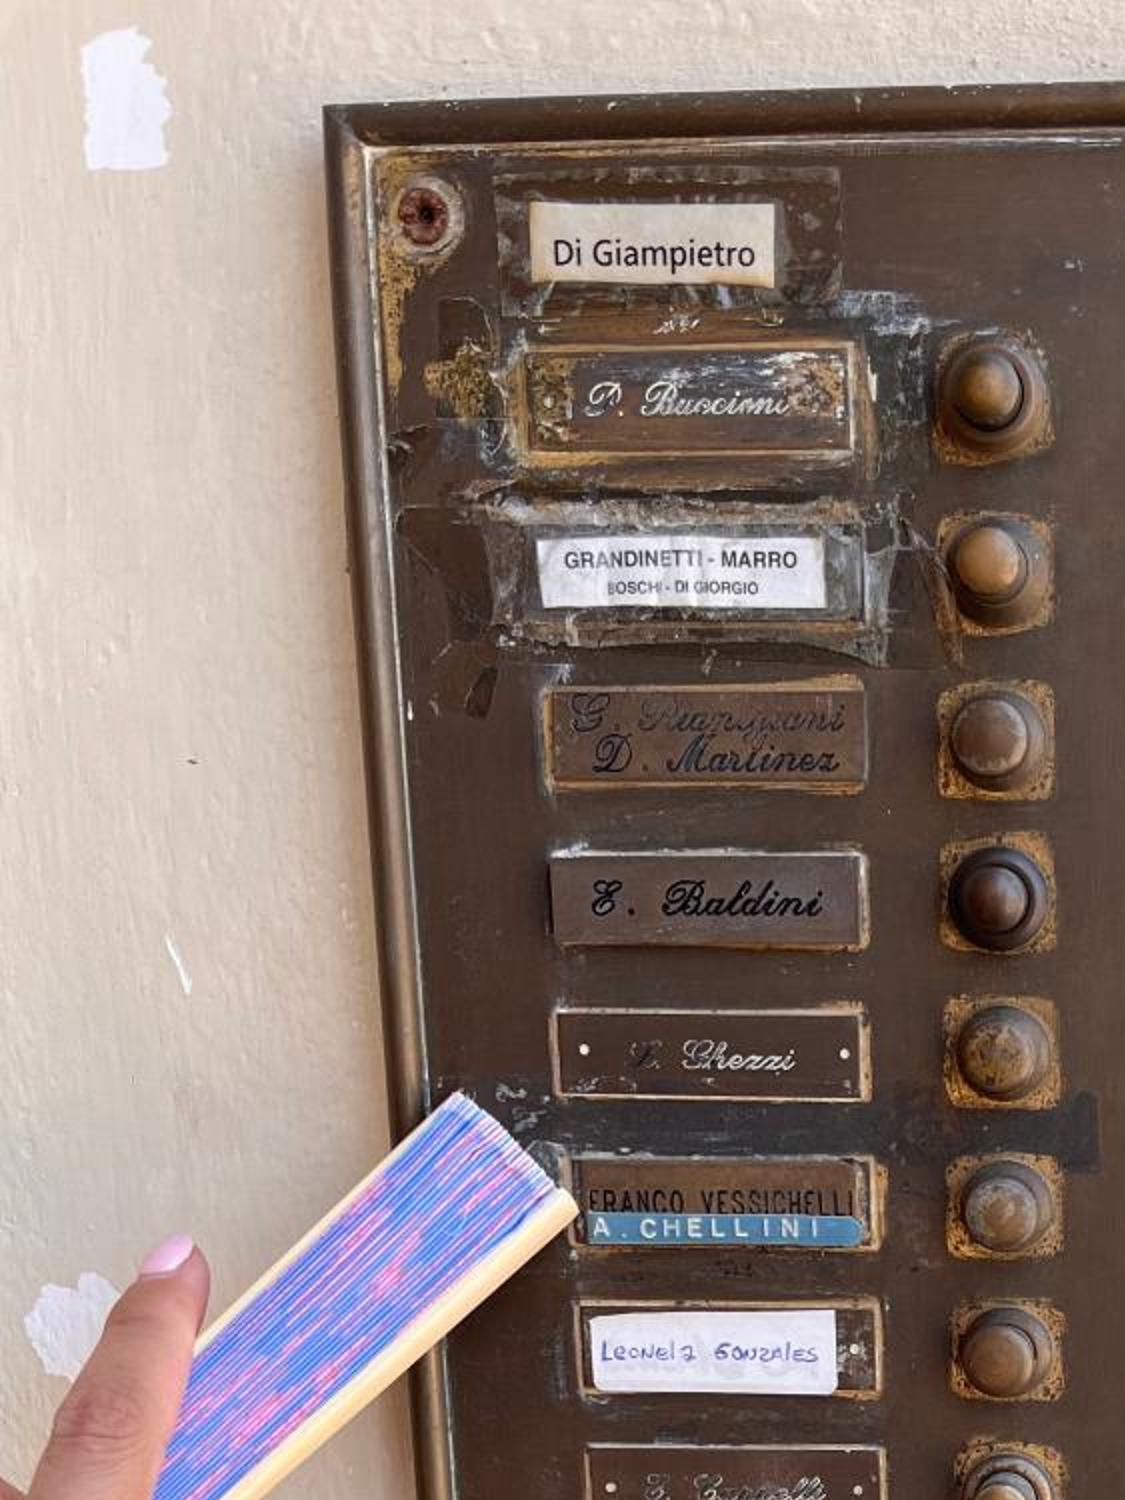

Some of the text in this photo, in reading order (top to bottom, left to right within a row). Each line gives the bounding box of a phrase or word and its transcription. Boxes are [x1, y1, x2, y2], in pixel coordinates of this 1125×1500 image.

[553, 238, 755, 274] Di Giampietro
[564, 549, 703, 570] GRANDINETTI
[721, 550, 798, 569] MARRO
[607, 581, 662, 596] BOSCHI
[675, 580, 689, 594] DI
[694, 581, 759, 596] GIORGIO
[592, 733, 842, 774] D. Martinez
[591, 879, 824, 918] E. Baldini
[681, 1039, 796, 1072] Ghezzi
[589, 1190, 685, 1214] FRANCO
[593, 1217, 819, 1239] A. CHELLINI
